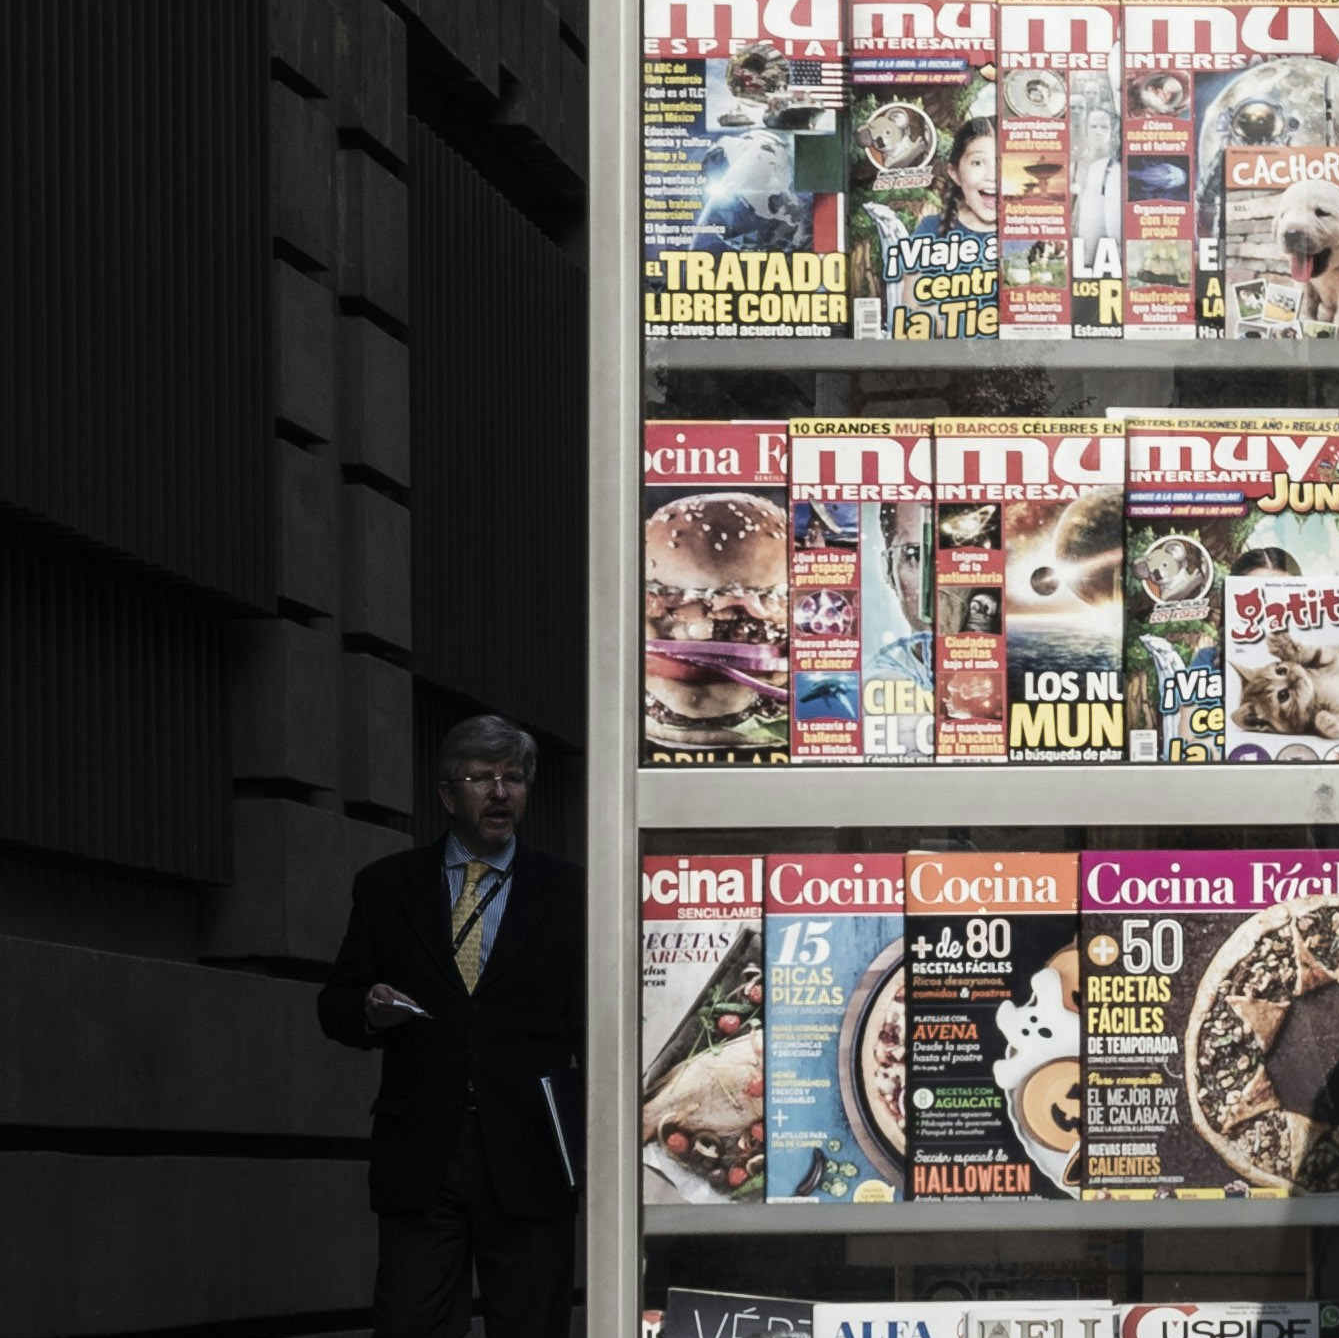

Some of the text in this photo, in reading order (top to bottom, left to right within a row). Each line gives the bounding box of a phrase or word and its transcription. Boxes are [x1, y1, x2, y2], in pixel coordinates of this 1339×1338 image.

[853, 38, 996, 50] INTERESANTE
[887, 236, 979, 277] ¡Viaje
[1073, 238, 1122, 278] LA
[645, 251, 846, 292] EL TRATADO
[645, 293, 847, 323] LIBRE COMER
[645, 323, 831, 337] Las claves del acuerdo entre
[793, 423, 890, 434] 10 GRANDES
[937, 419, 1122, 434] 10 BARCOS CÉLEBRES EN
[1178, 418, 1330, 432] ESTACIONES DEL AÑO REGLAS
[1130, 436, 1327, 482] muy
[1130, 470, 1272, 483] INTERESANTE
[945, 636, 997, 648] Ciudades
[1025, 671, 1079, 701] LOS
[1010, 703, 1123, 747] MUN
[1025, 749, 1098, 761] búsqueda de
[910, 861, 1059, 904] Cocina
[1087, 862, 1236, 905] Cocina
[774, 921, 832, 966] 15
[936, 918, 1011, 959] de 80
[1122, 919, 1183, 974] 50
[912, 959, 1012, 974] RECETAS FÁCILES
[771, 968, 833, 986] RICAS
[771, 987, 844, 1005] PIZZAS
[1087, 976, 1171, 1003] RECETAS
[1087, 1005, 1165, 1034] FÁCILES
[912, 1024, 979, 1040] AVENA
[1088, 1036, 1178, 1054] DE TEMPORADA
[935, 1097, 1001, 1108] AGUACATE
[1088, 1088, 1179, 1106] EL MEJOR PAY
[1088, 1107, 1179, 1125] DE CALABAZA
[1088, 1143, 1157, 1156] NUEVAS BEBIDAS
[1088, 1157, 1161, 1176] CALIENTES
[914, 1164, 1030, 1194] HALLOWEEN
